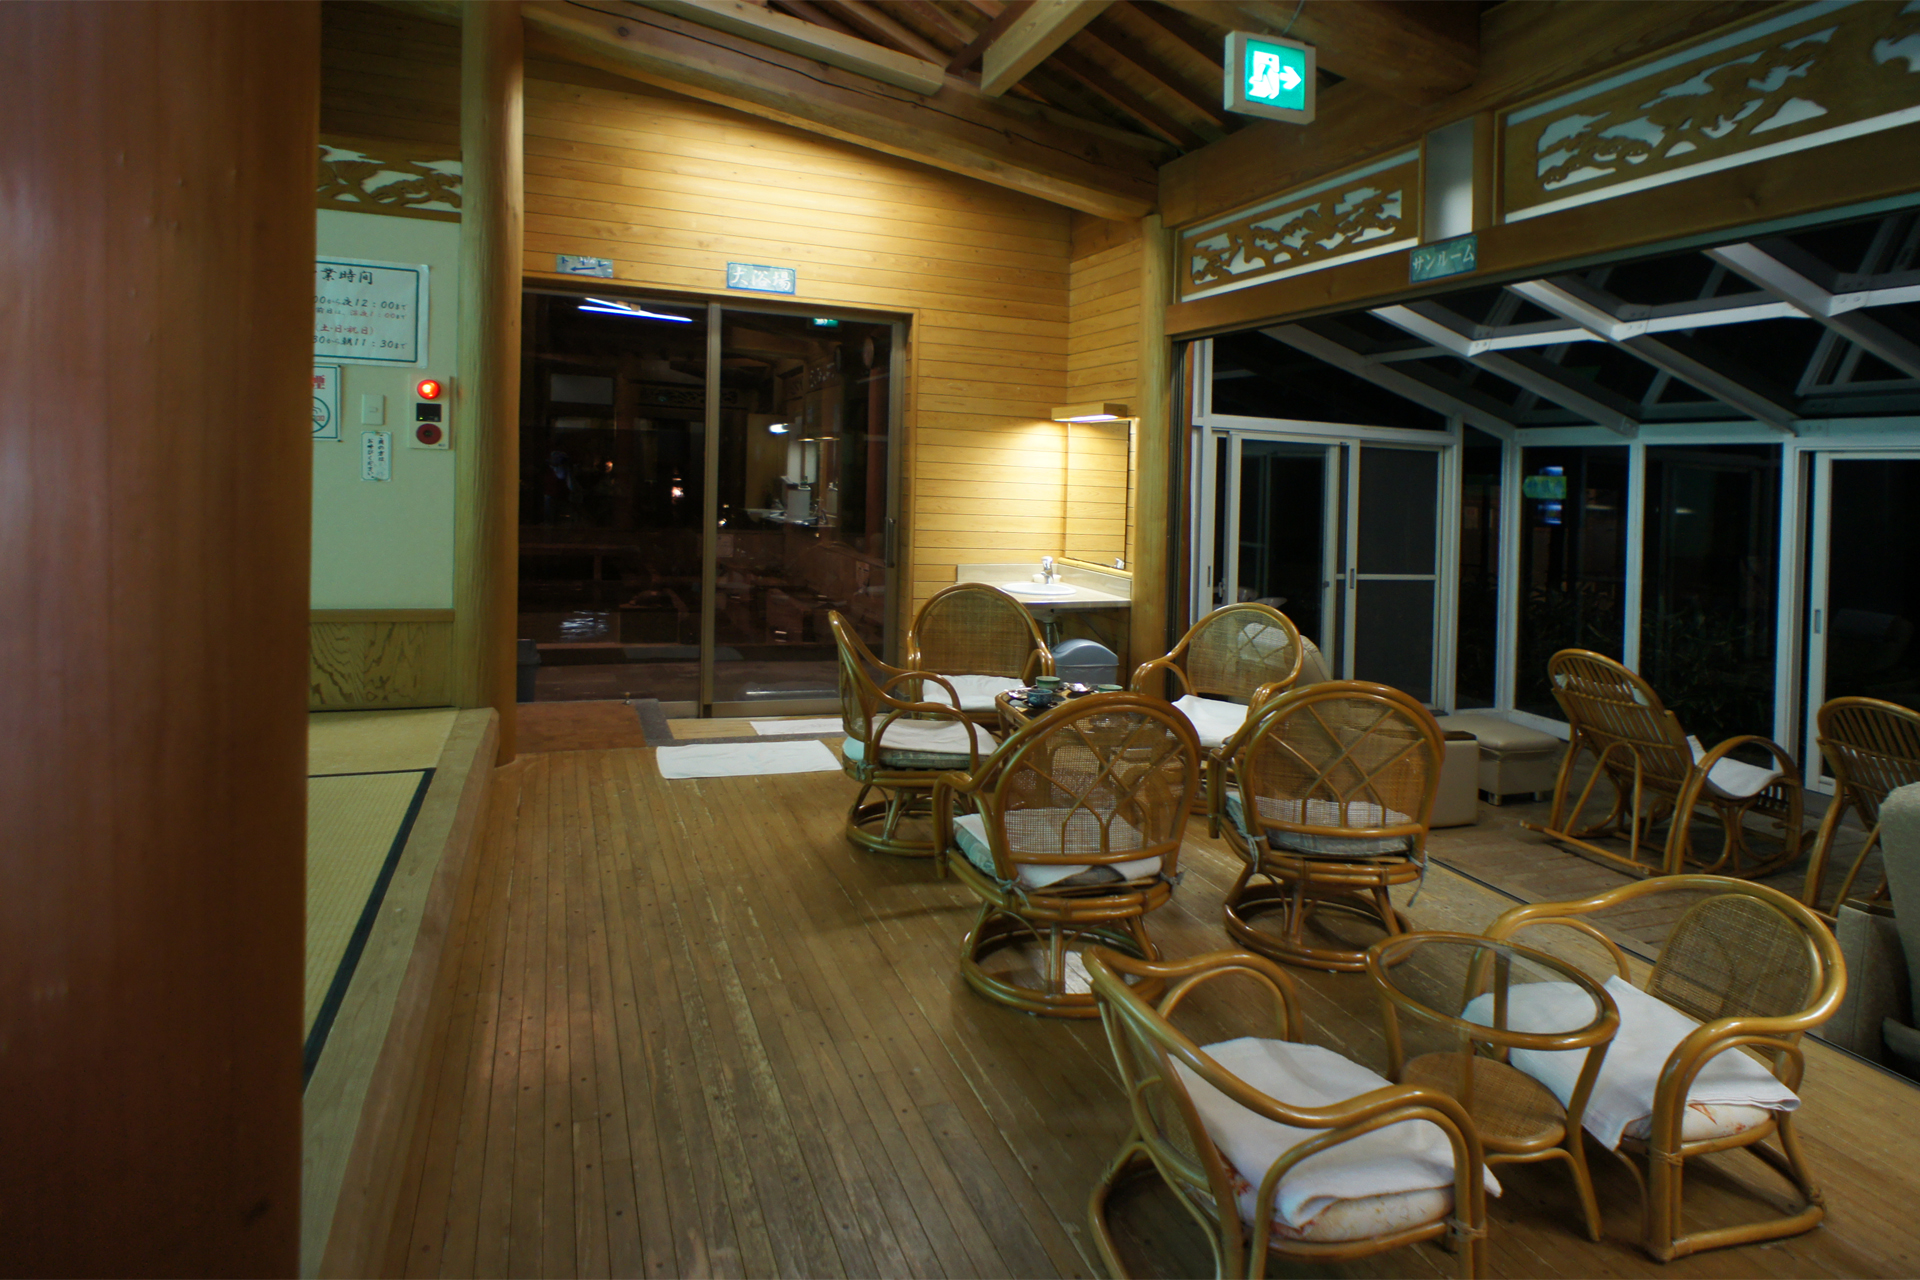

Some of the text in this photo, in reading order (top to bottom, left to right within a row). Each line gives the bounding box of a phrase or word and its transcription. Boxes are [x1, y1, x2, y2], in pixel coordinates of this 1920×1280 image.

[1412, 244, 1475, 273] サンルーム
[315, 267, 373, 285] 業時間
[730, 266, 791, 291] 大浴場
